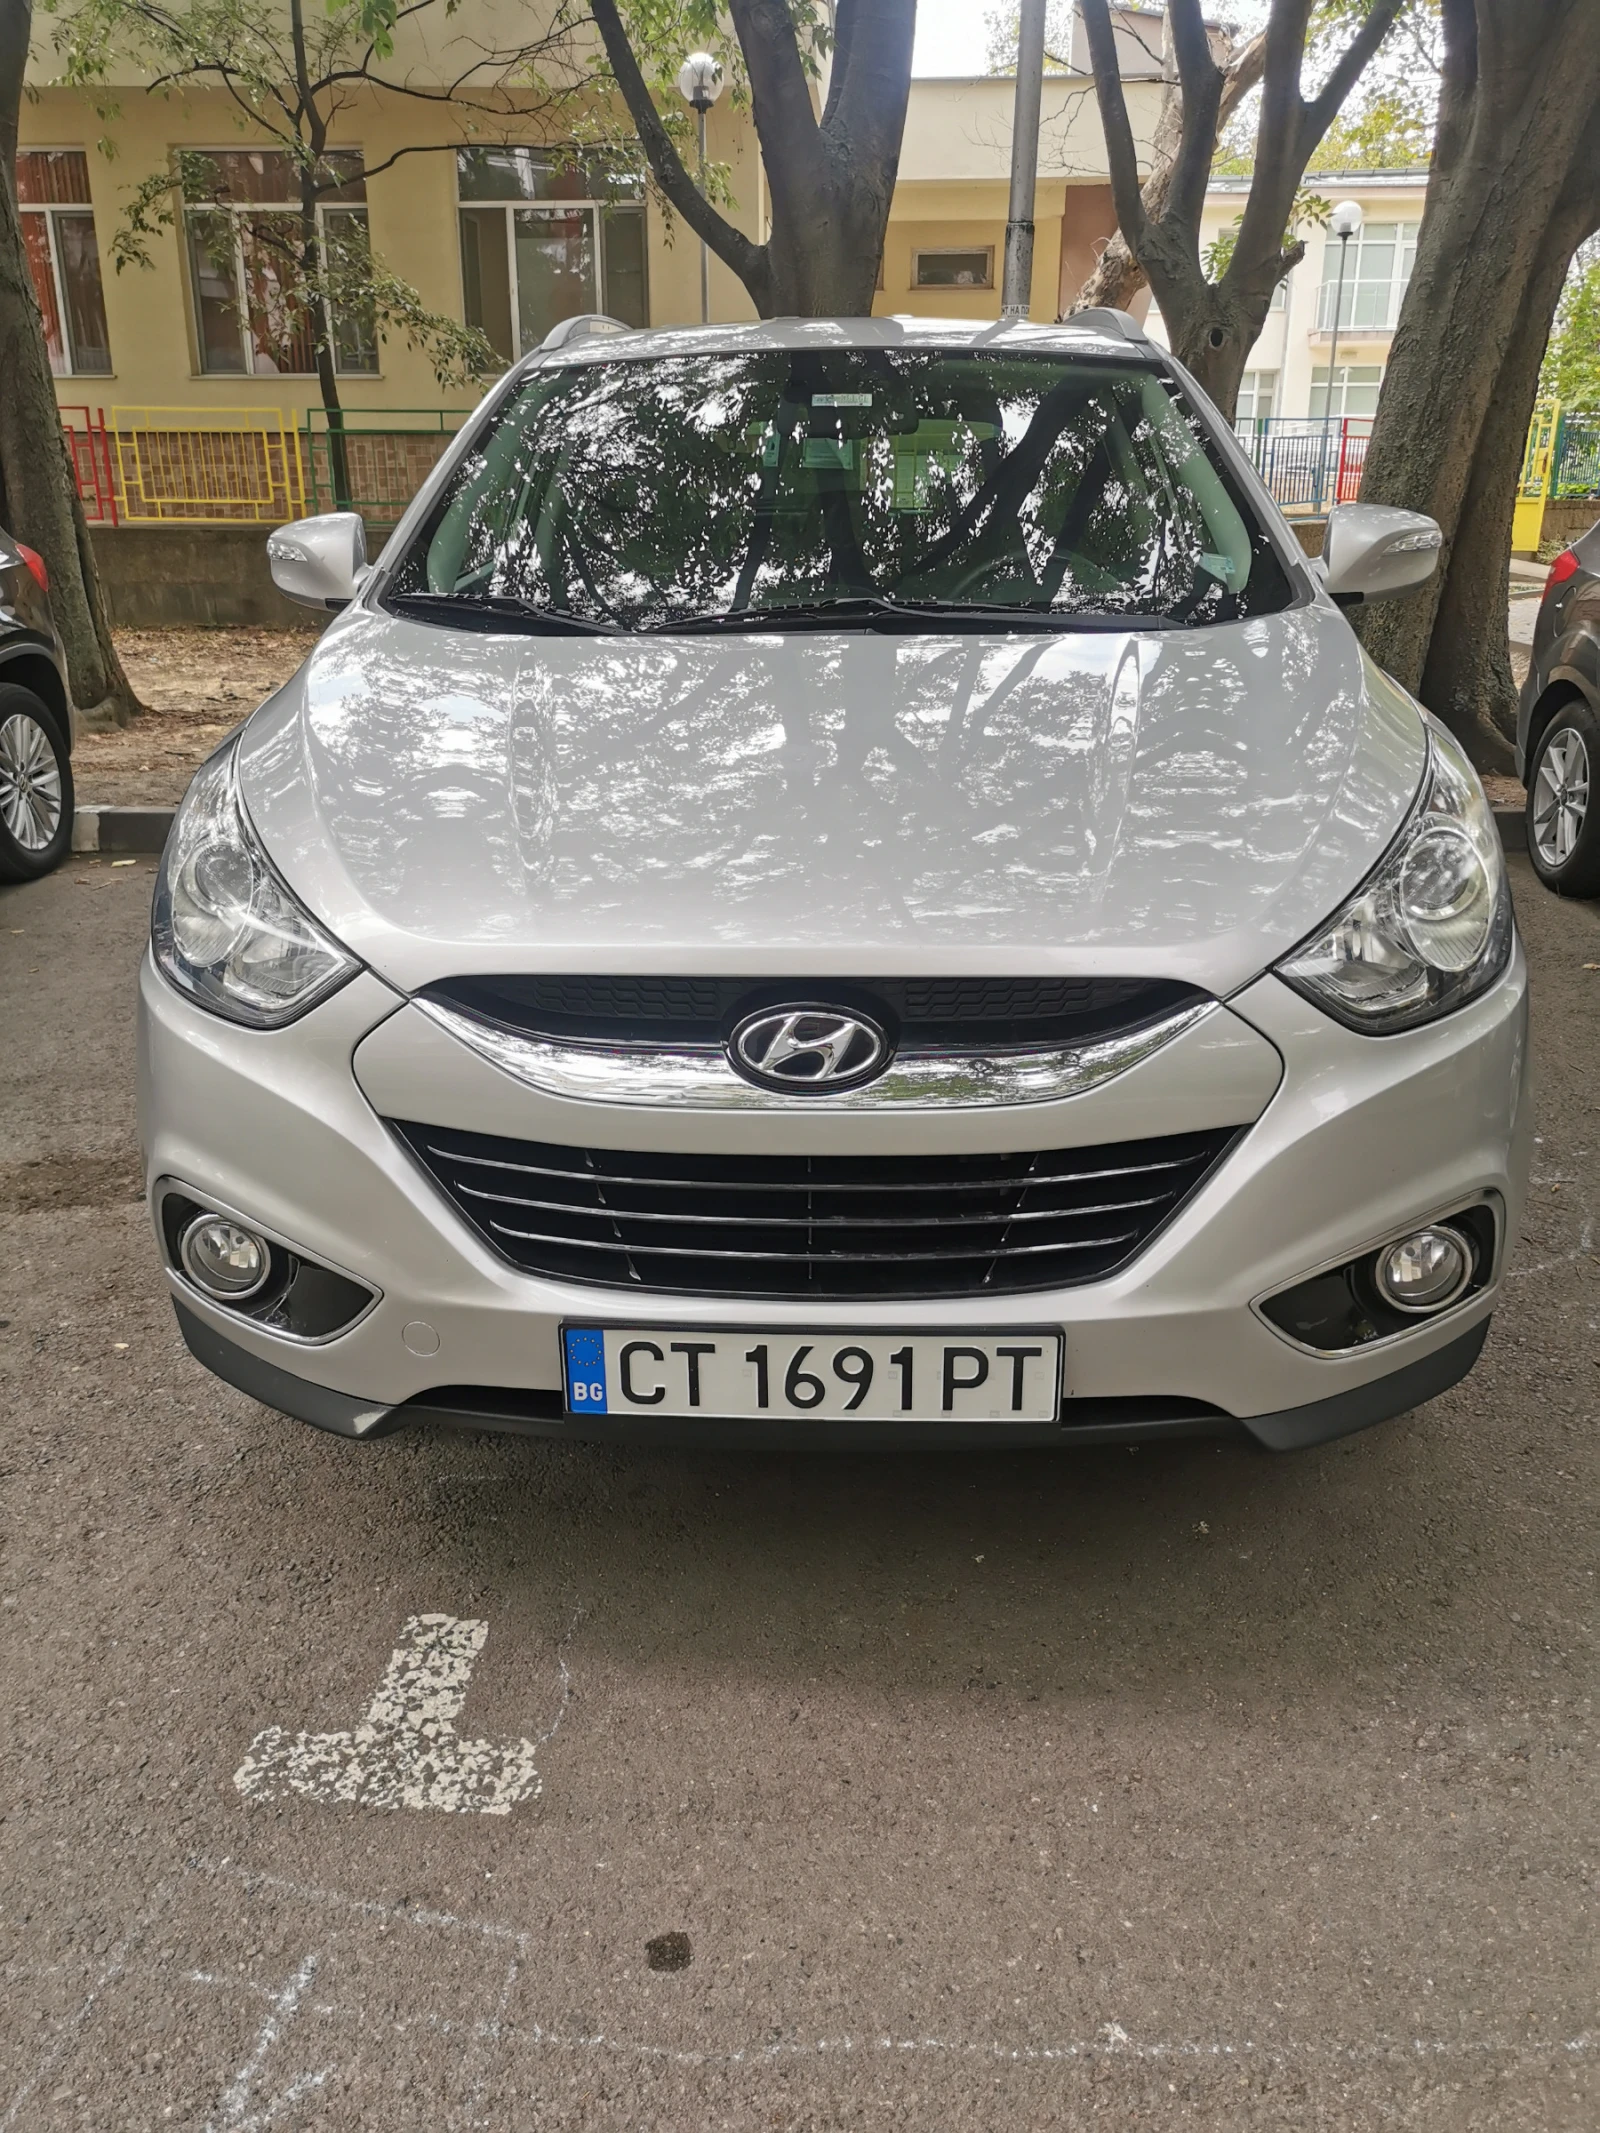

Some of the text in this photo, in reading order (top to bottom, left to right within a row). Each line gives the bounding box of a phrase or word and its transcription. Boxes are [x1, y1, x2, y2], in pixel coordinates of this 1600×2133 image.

[1010, 305, 1020, 315] НА
[618, 1341, 1043, 1411] CT 1691 PT
[573, 1381, 604, 1402] BG
